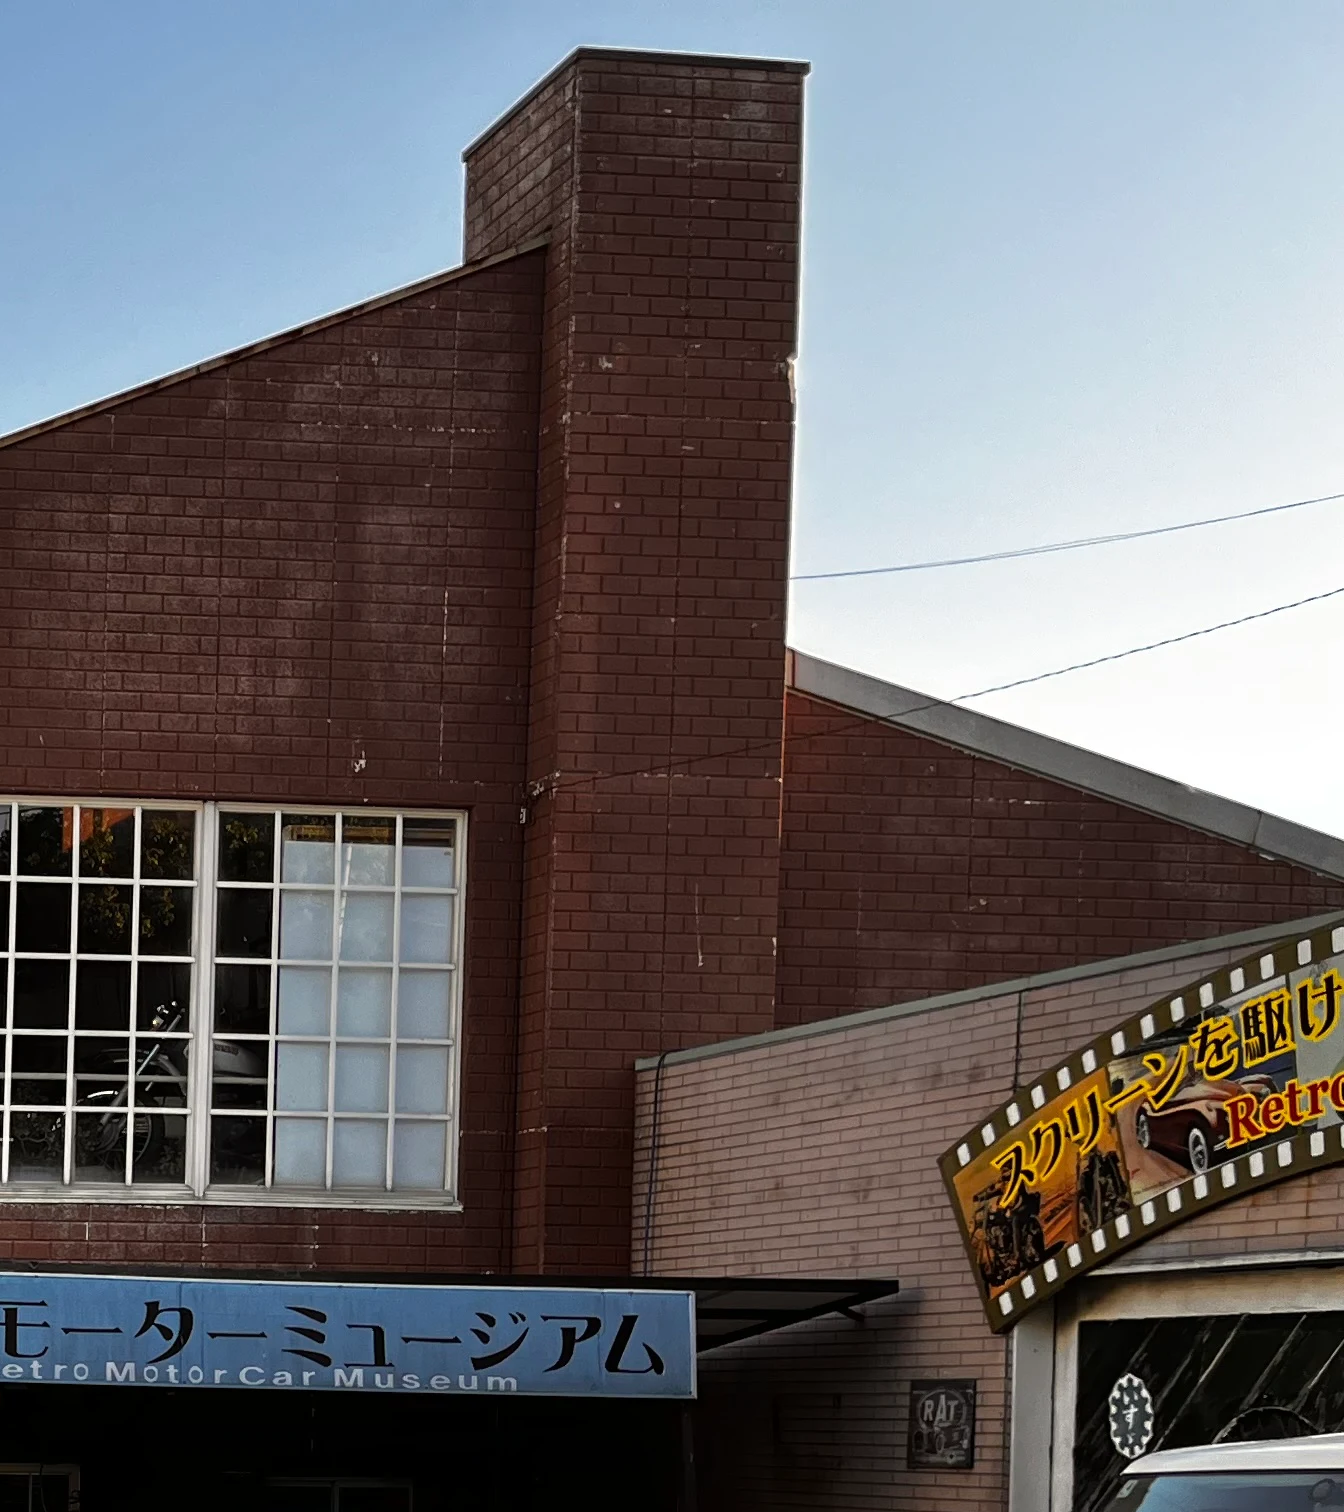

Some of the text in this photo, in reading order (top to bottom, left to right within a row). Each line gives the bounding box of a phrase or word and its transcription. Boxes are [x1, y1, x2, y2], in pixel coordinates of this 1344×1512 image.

[991, 968, 1344, 1208] スクリーンを駆け
[333, 1368, 519, 1391] Museum
